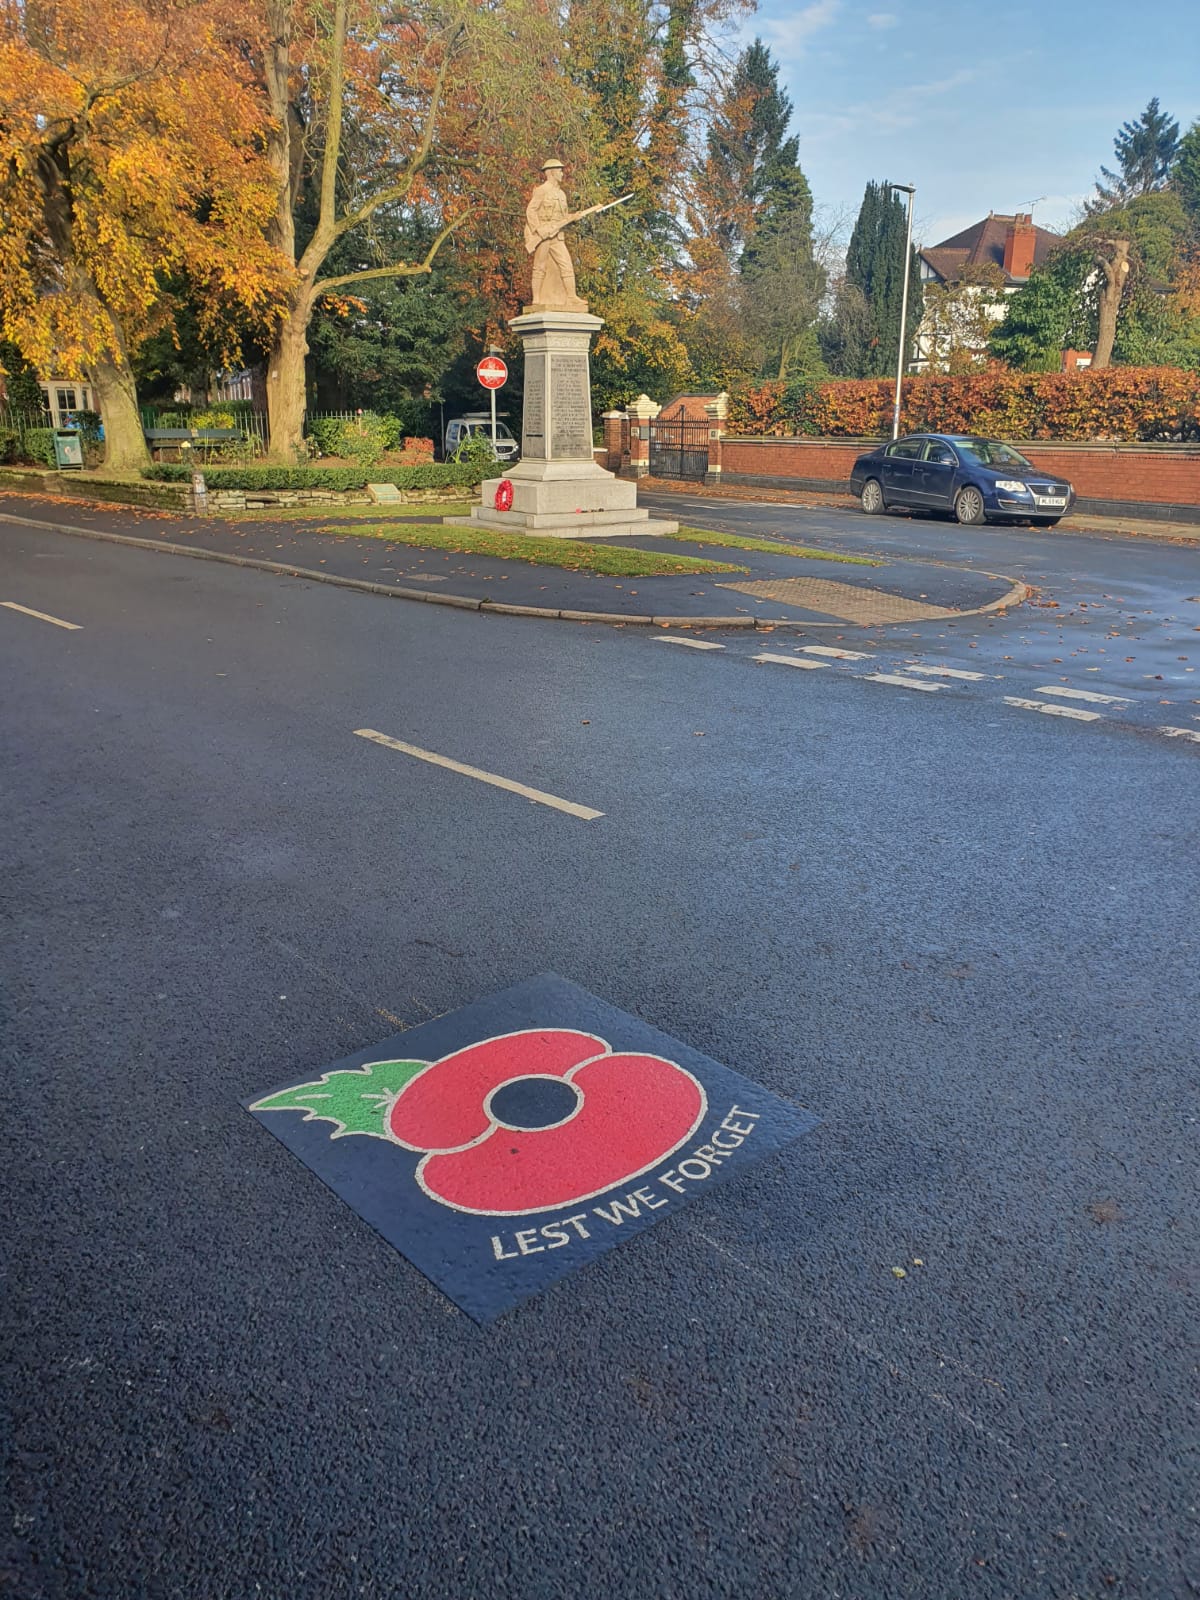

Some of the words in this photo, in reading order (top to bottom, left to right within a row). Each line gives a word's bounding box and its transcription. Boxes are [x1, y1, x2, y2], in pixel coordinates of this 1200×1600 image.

[491, 1214, 591, 1260] LEST
[593, 1186, 669, 1226] WE
[658, 1104, 760, 1193] FORGET
